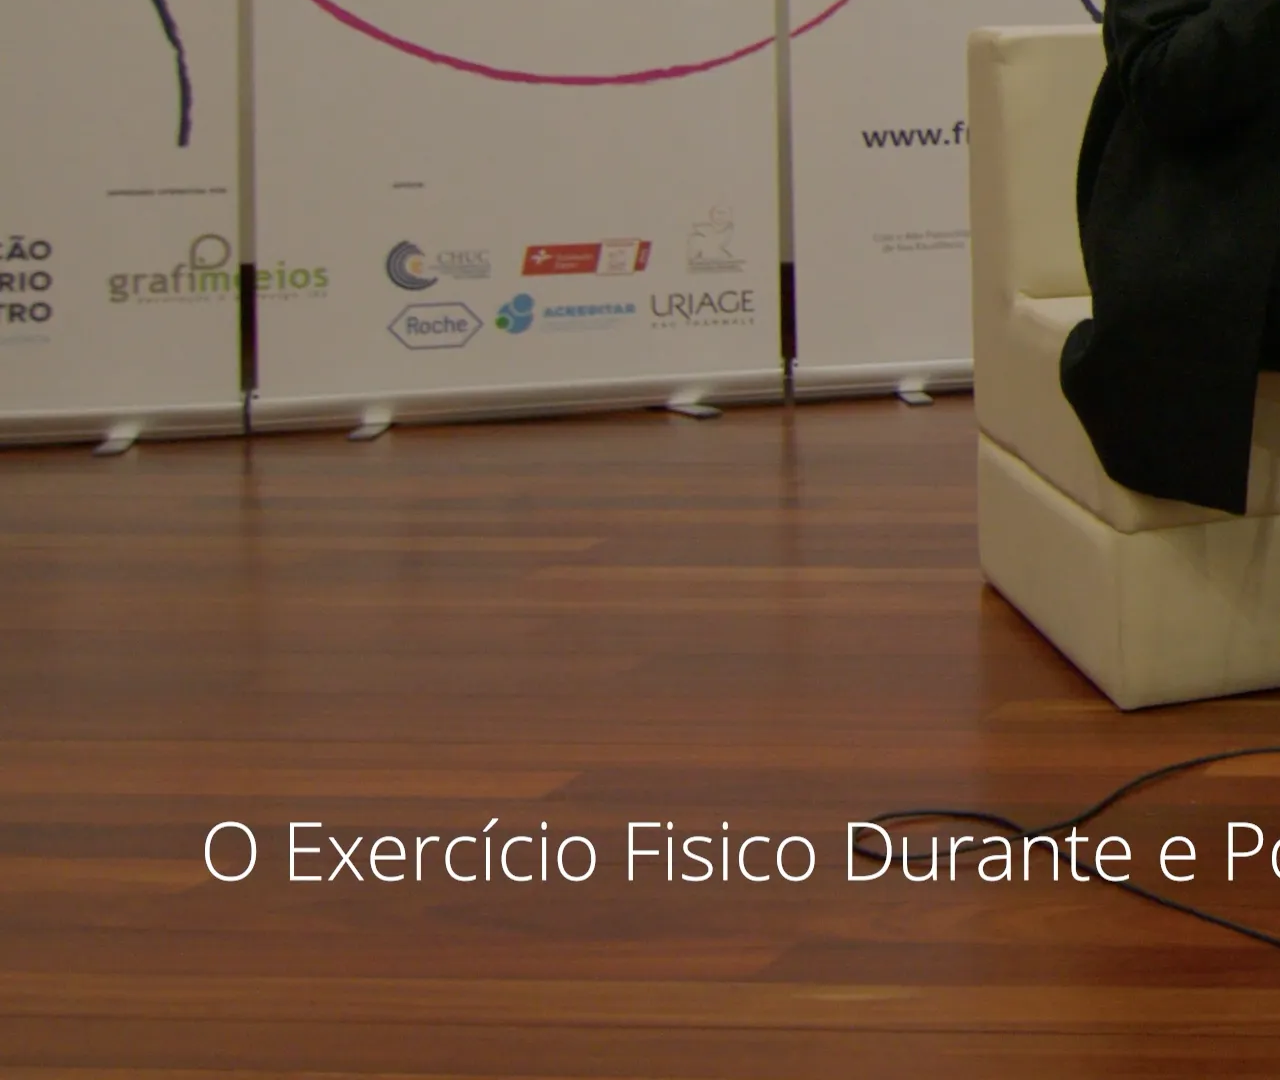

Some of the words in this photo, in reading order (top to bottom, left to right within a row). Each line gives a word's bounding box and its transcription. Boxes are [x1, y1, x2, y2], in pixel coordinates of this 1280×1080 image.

[0, 235, 52, 262] ÃO
[651, 290, 756, 321] URIAGE
[407, 316, 469, 336] Roche
